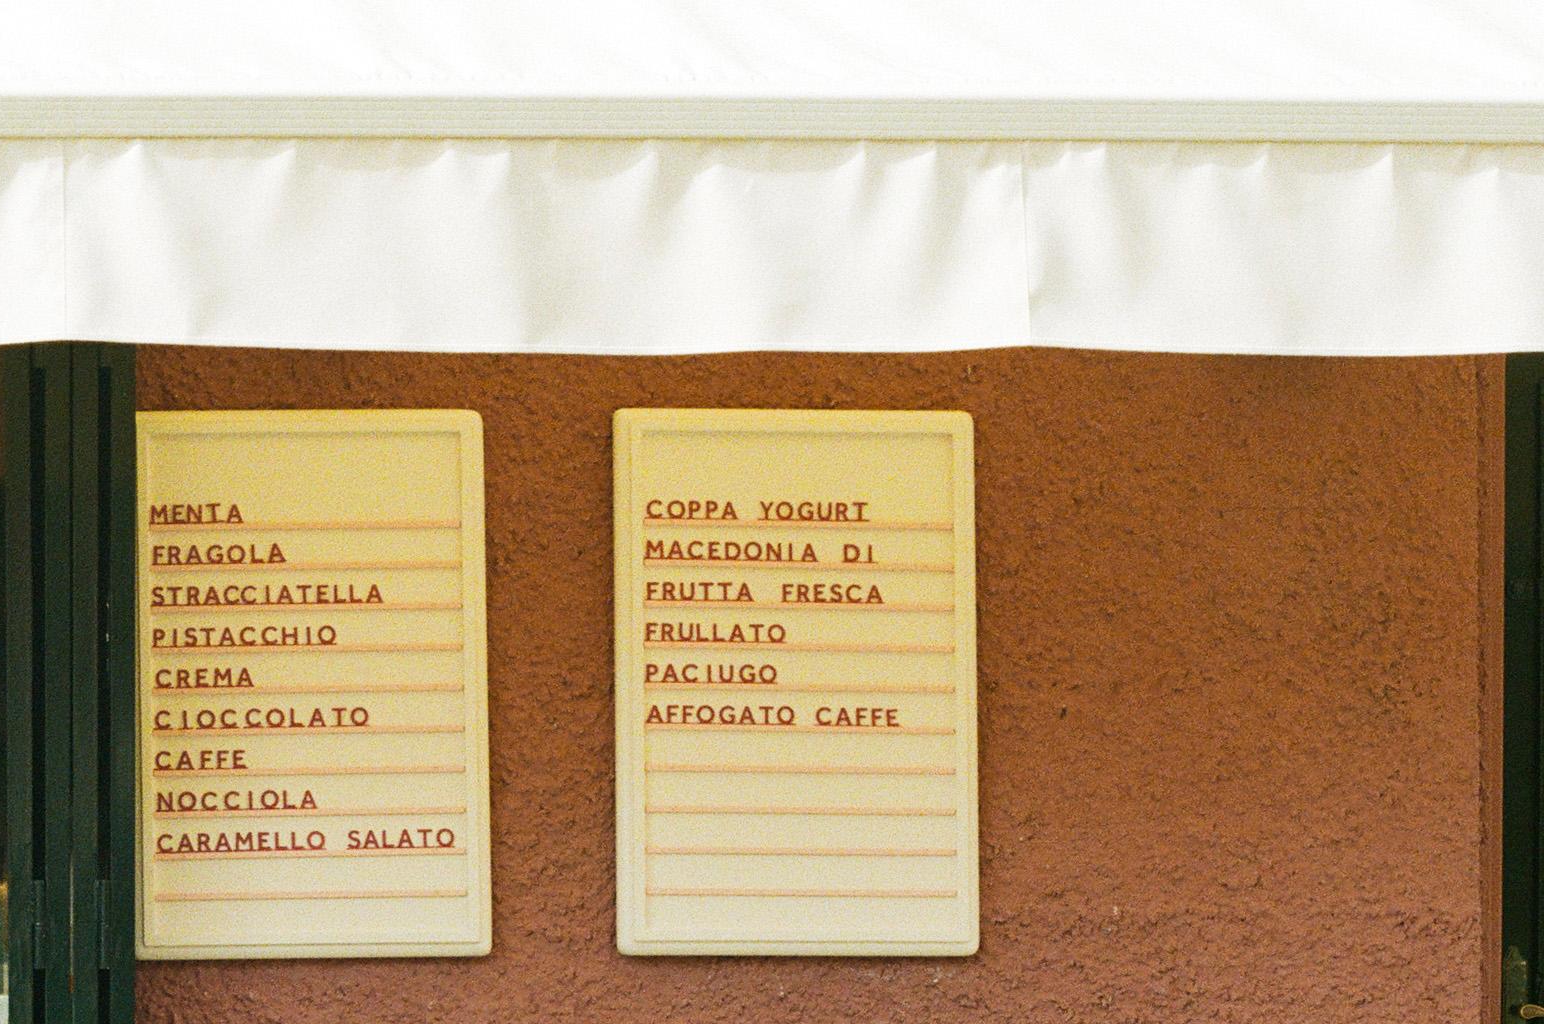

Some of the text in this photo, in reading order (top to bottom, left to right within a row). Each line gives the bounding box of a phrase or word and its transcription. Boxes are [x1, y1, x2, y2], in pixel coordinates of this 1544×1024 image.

[149, 503, 244, 524] MENTA
[645, 499, 869, 521] COPPA YOGURT
[152, 543, 287, 565] FRAGOLA
[644, 540, 877, 563] MACEDONIA DI
[151, 584, 384, 606] STRACCIATELLA
[645, 582, 884, 604] FRUTTA FRESCA
[152, 625, 337, 647] PISTACCHIO
[644, 622, 786, 643] FRULLATO
[154, 667, 254, 689] CREMA
[645, 664, 777, 684] PACIUGO
[153, 707, 370, 729] CIOCCOLATO
[645, 704, 900, 727] AFFOGATO CAFFE
[154, 749, 248, 770] CAFFE
[155, 790, 318, 812] NOCCIOLA
[155, 828, 455, 854] CARAMELLO SALATO
